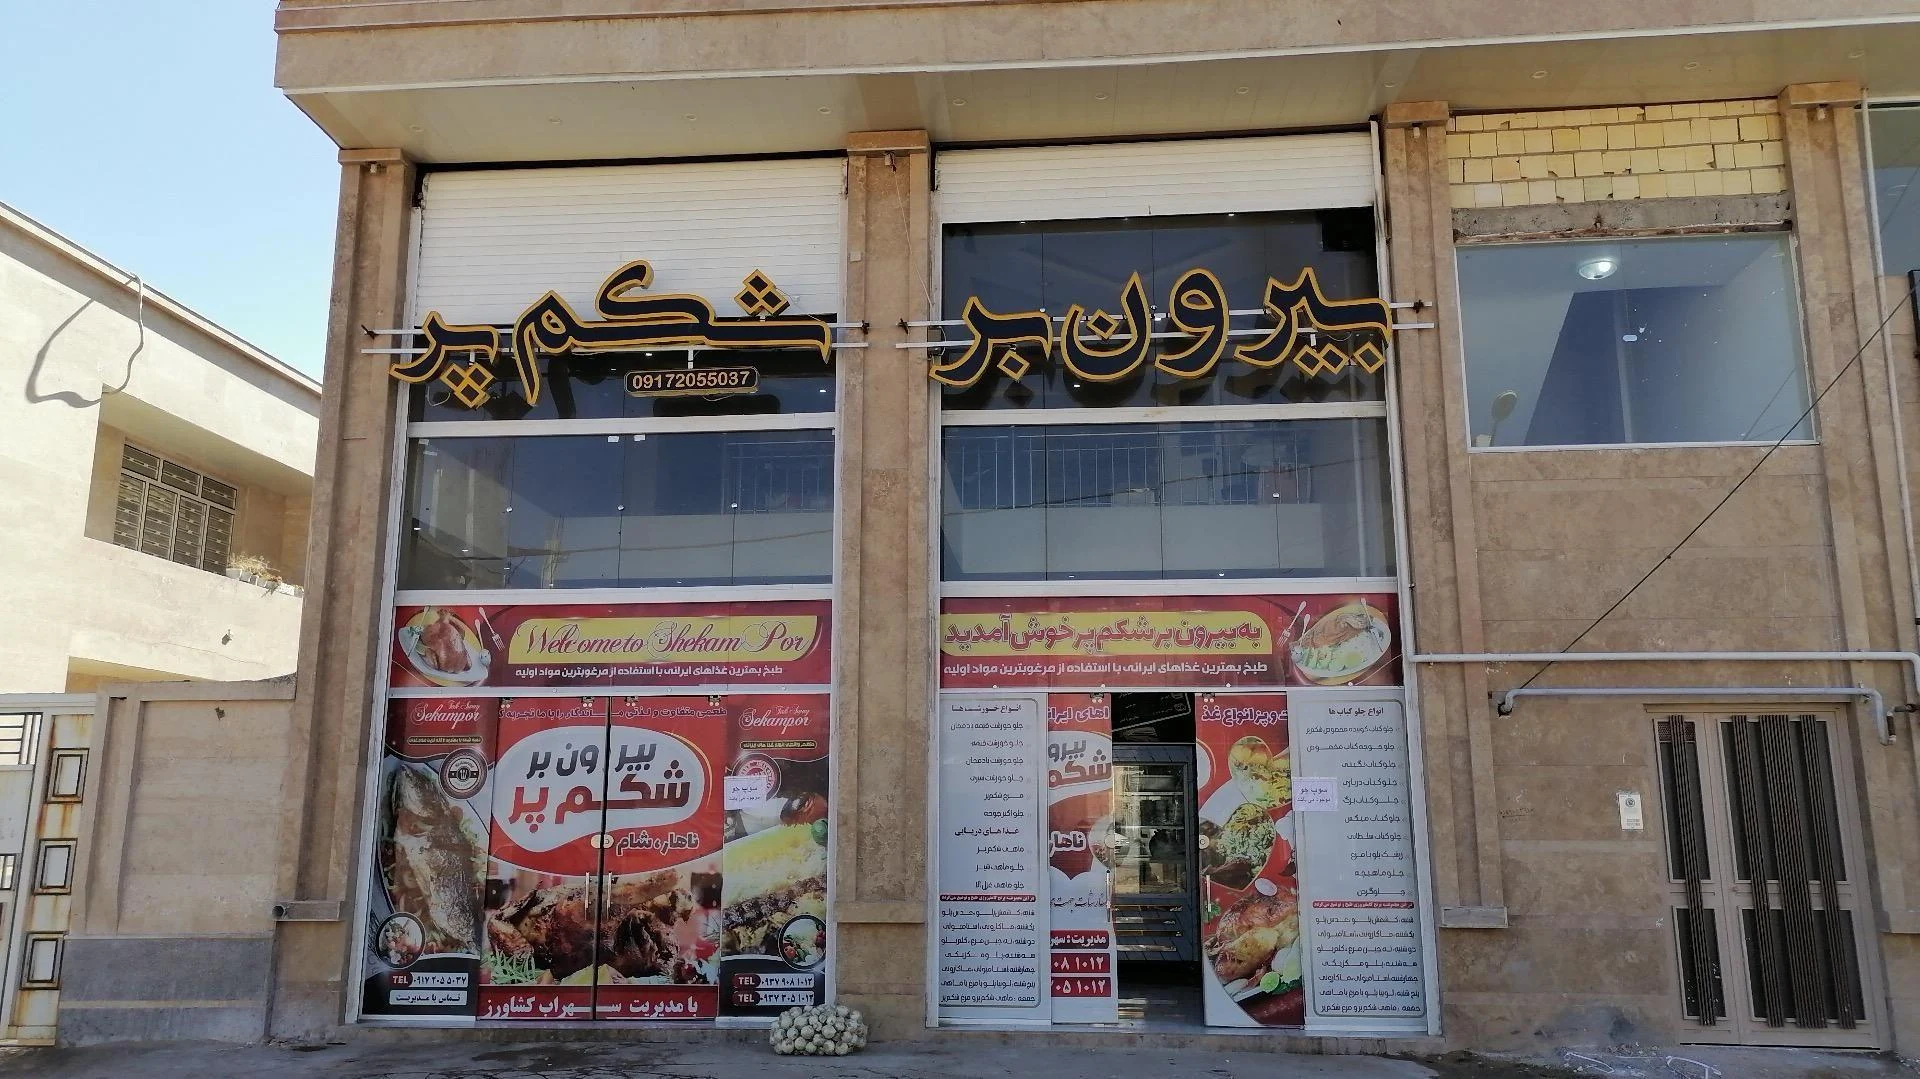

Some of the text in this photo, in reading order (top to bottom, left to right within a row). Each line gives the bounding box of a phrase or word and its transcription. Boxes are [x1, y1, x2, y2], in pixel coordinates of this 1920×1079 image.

[388, 259, 1393, 409] بیرون بر شکم پر
[632, 371, 750, 390] 09172055037
[945, 613, 1011, 651] آمدید
[1010, 615, 1073, 651] خوش
[1095, 615, 1155, 652] شکم
[1237, 622, 1263, 648] به
[647, 620, 741, 659] Shekam
[742, 620, 809, 653] Por
[1072, 628, 1097, 654] پر
[515, 668, 538, 679] اولیه
[539, 668, 560, 679] مواد
[609, 667, 617, 679] از
[617, 666, 655, 676] استفاده
[655, 666, 664, 677] با
[664, 665, 692, 678] ایرانی
[728, 665, 762, 678] بهترین
[762, 665, 783, 677] طبخ
[945, 664, 970, 676] اولیه
[971, 663, 998, 676] مواد
[1056, 663, 1065, 676] از
[1066, 662, 1111, 674] استفاده
[1112, 662, 1122, 675] با
[1123, 661, 1157, 677] ایرانی
[1158, 661, 1200, 675] غذاهای
[1201, 662, 1241, 677] بهترین
[1242, 662, 1268, 676] طبخ
[505, 708, 536, 721] تجربه
[536, 708, 547, 718] ما
[547, 708, 556, 720] با
[625, 706, 652, 719] لذتی
[652, 709, 660, 719] و
[660, 706, 696, 719] متفاوت
[696, 707, 728, 719] طعمی
[1222, 708, 1254, 727] انواع
[1328, 706, 1384, 717] انواع چلو کباب ها
[526, 743, 657, 780] بیرون بر
[554, 759, 690, 825] شکم
[508, 786, 550, 834] پر
[616, 830, 652, 856] شام
[1075, 956, 1104, 970] ۱۰۱۲
[392, 975, 409, 984] TEL
[738, 976, 756, 986] TEL
[1077, 979, 1106, 994] ۱۰۱۲
[431, 993, 438, 1003] با
[438, 993, 461, 1004] تماس
[738, 993, 755, 1003] TEL
[482, 995, 536, 1019] کشاورز
[629, 999, 684, 1018] مدیریت
[687, 995, 698, 1018] با
